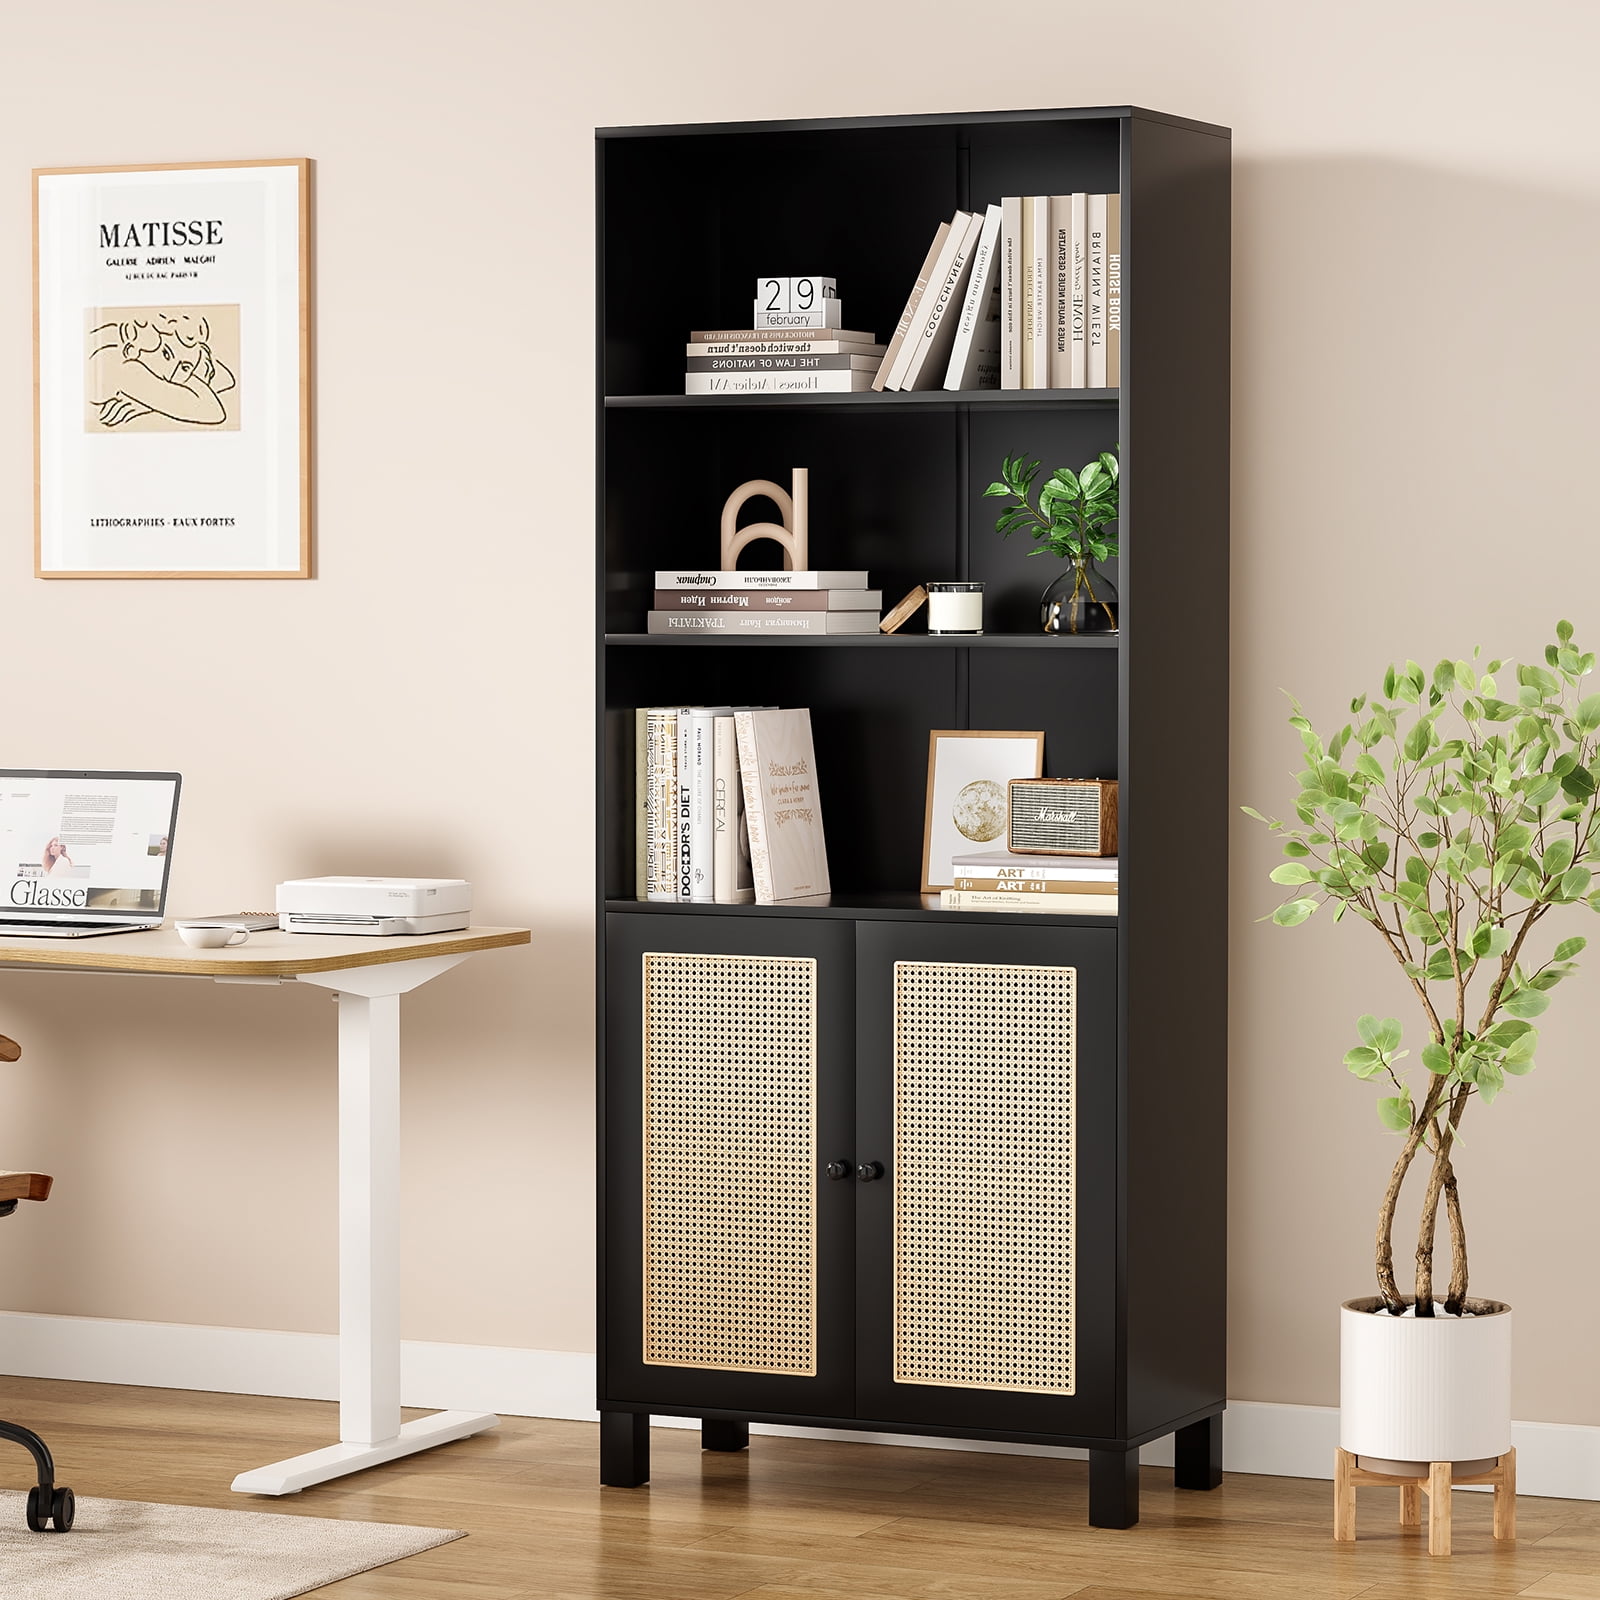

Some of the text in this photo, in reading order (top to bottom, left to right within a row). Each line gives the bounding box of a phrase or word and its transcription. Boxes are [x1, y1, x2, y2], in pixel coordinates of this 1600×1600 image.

[99, 220, 224, 248] MATISSE
[767, 314, 810, 326] february
[90, 518, 235, 527] LITHOGRAPHIES EAUX FORTES
[676, 574, 717, 586] Спартак
[680, 595, 749, 606] Мартин Иден
[668, 617, 725, 628] ТРАКТАТЫ
[739, 618, 809, 628] Иммануил Кант
[681, 786, 690, 818] DIET
[1034, 808, 1077, 822] Marshall
[997, 869, 1025, 878] ART
[996, 881, 1026, 891] ART
